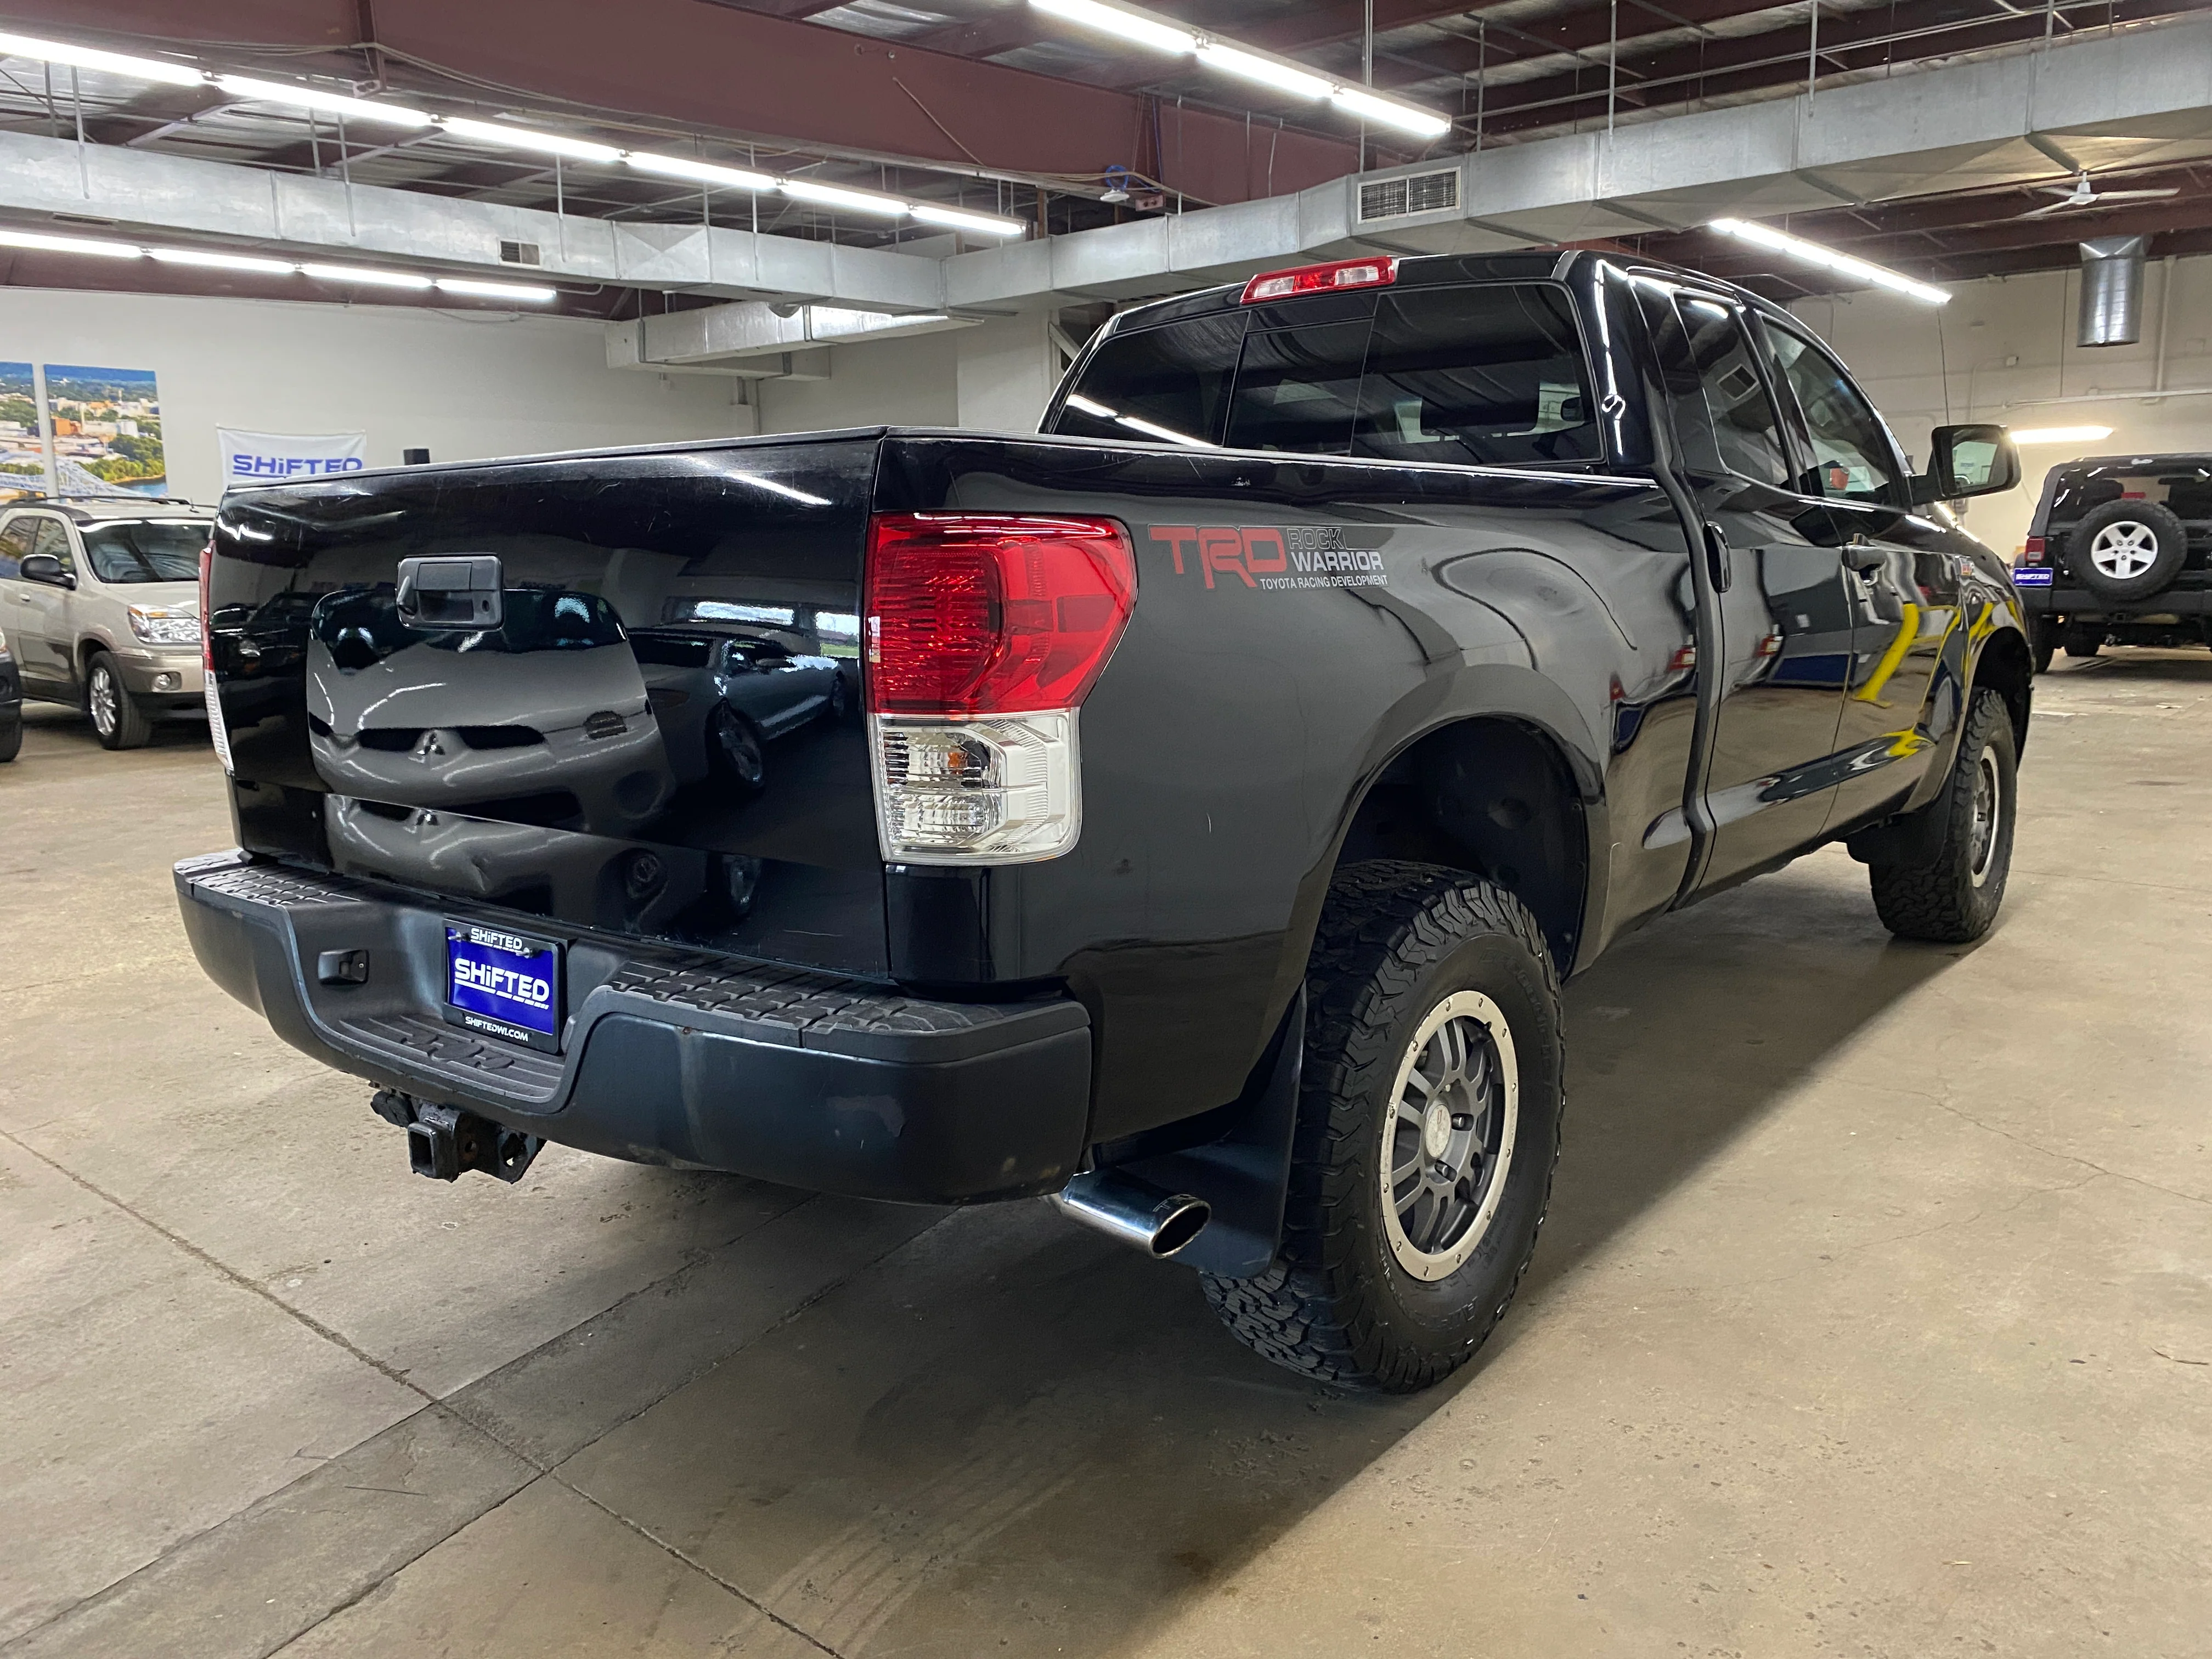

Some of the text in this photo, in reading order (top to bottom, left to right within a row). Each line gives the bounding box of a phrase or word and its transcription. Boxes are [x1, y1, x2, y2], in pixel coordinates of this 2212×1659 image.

[1286, 528, 1345, 550] ROCK
[1149, 525, 1288, 589] TRD
[1290, 551, 1385, 572] WARRIOR
[1260, 575, 1389, 590] TOYOTA RACING DEVELOPMENT
[465, 1016, 528, 1042] SHIFTEDWI.COM
